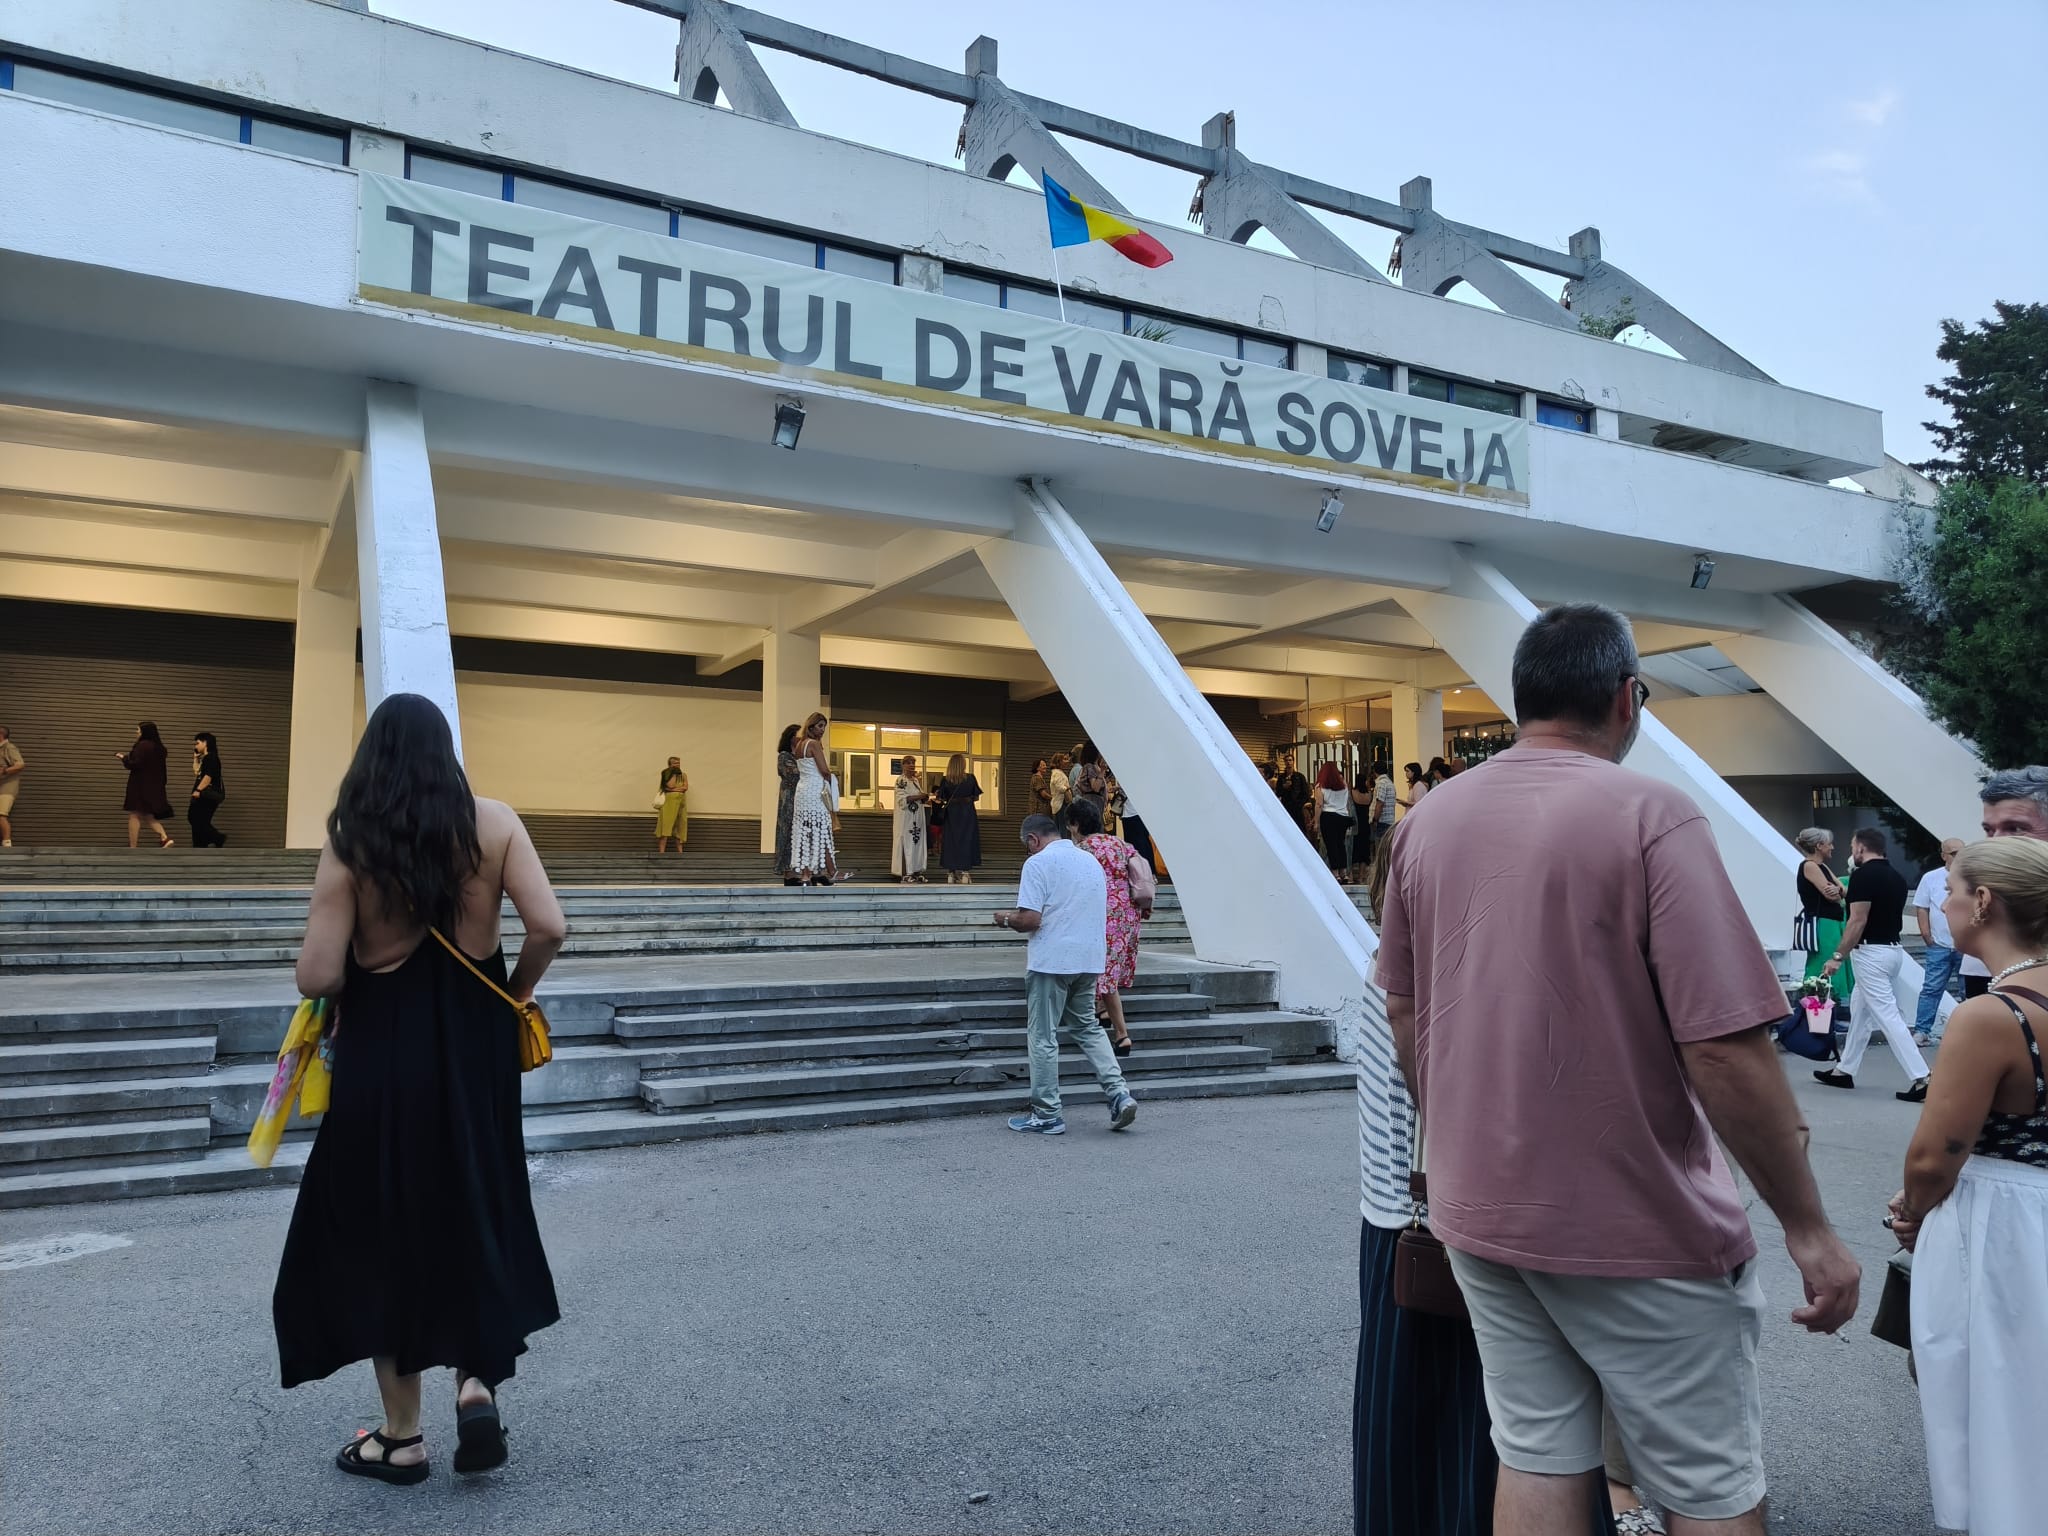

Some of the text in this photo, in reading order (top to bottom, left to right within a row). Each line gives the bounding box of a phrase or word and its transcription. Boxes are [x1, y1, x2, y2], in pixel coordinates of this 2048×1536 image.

[386, 205, 1515, 490] TEATRUL DE VARĂ SOVEJA
